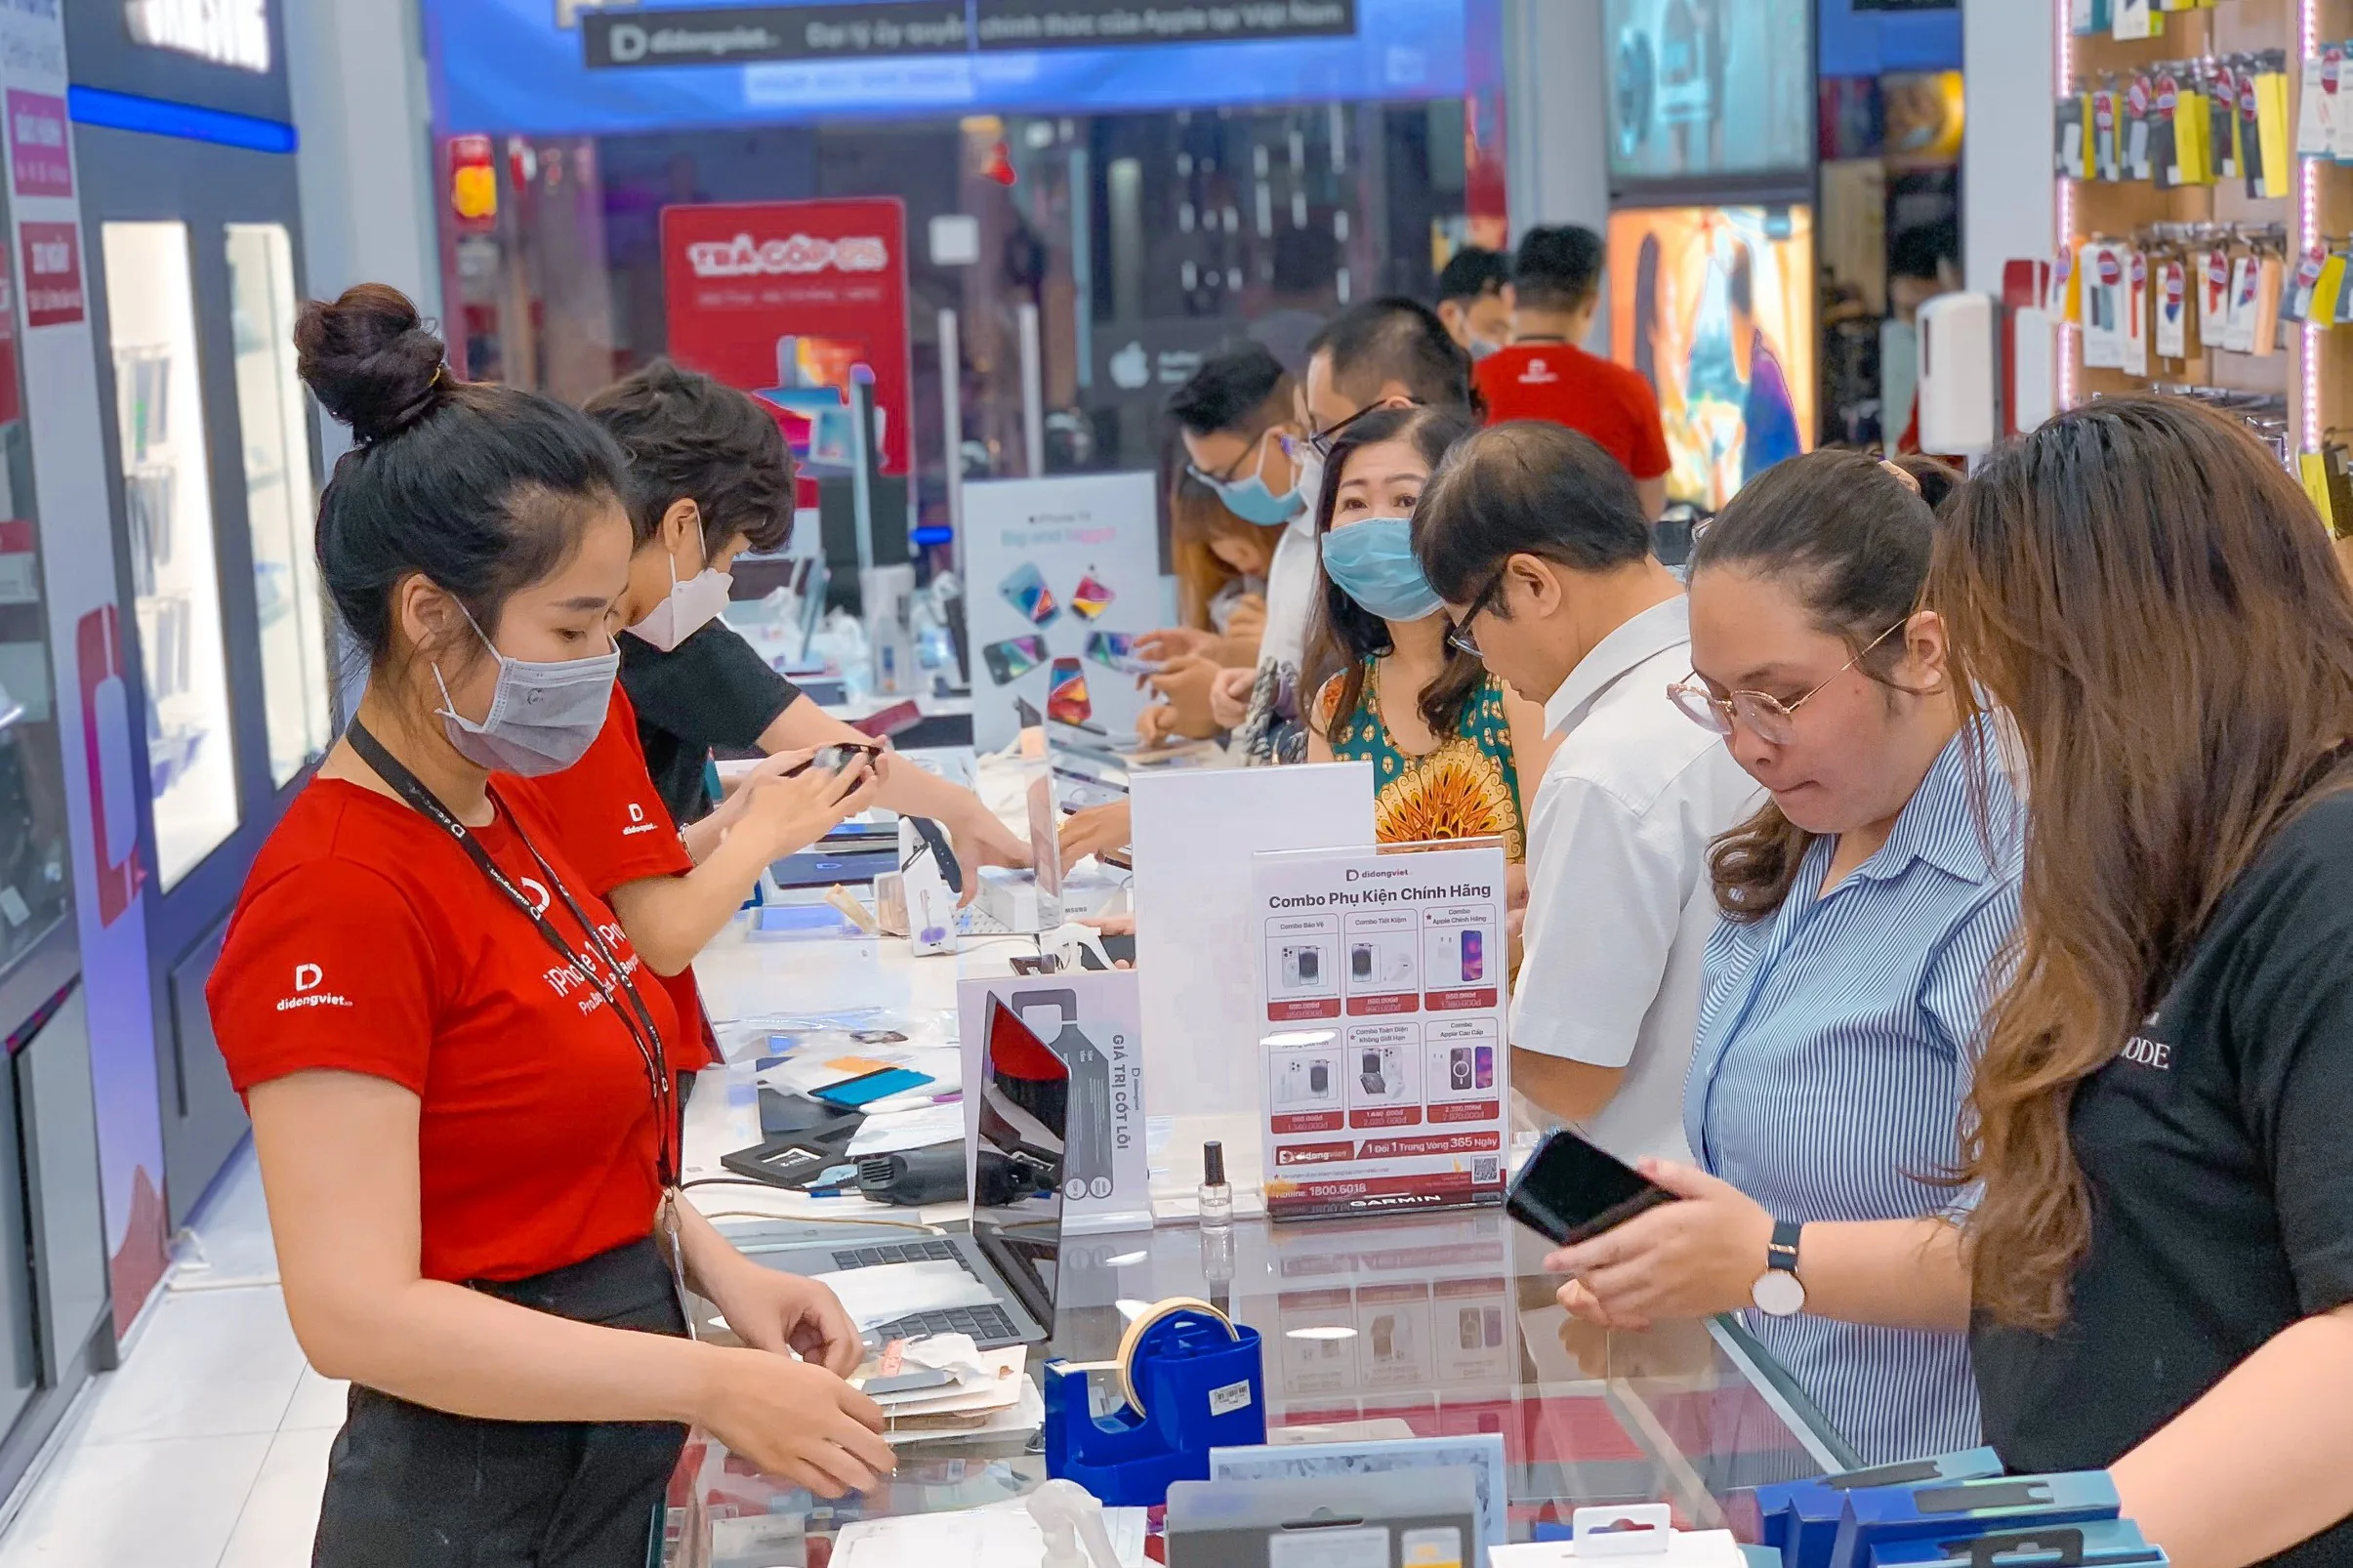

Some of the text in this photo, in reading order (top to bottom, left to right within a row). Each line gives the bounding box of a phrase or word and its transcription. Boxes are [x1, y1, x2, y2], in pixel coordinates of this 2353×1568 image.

[1362, 868, 1409, 880] didongviet
[1268, 884, 1492, 909] Combo Phụ Kiện Chính Hãng
[543, 952, 598, 997] iPhoe
[2122, 1037, 2171, 1069] ODE
[1111, 1034, 1131, 1149] GIÁ TRỊ CỐT LÕI
[1399, 1143, 1425, 1153] Trong
[1450, 1136, 1472, 1148] 365
[1309, 1182, 1367, 1196] 1800.6018
[1350, 1194, 1441, 1207] GARMIN
